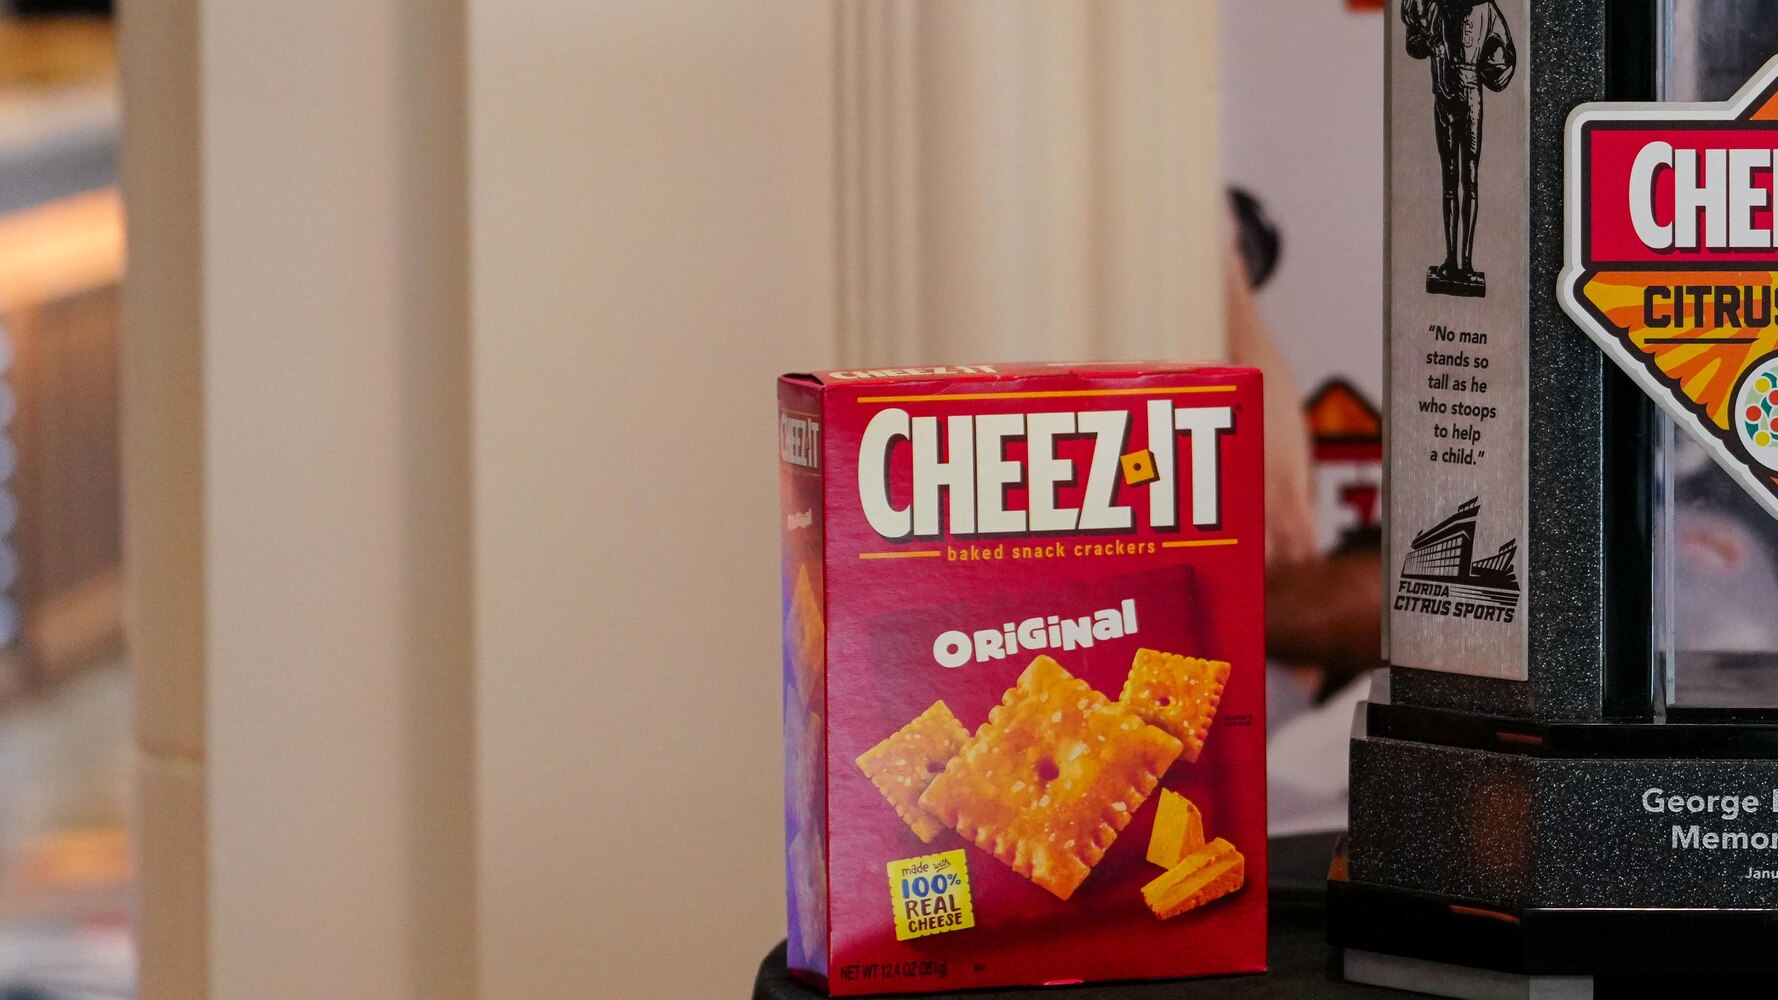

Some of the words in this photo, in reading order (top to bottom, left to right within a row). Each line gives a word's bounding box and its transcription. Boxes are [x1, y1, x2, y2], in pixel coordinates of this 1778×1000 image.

[1459, 331, 1487, 344] man
[1426, 351, 1470, 368] stands
[1473, 357, 1489, 369] so
[1428, 374, 1448, 390] tall
[1452, 379, 1467, 391] as
[1471, 376, 1487, 393] he
[1418, 397, 1447, 414] who
[1451, 401, 1496, 421] stoops
[1434, 424, 1448, 438] to
[1452, 423, 1481, 445] help
[1430, 450, 1437, 461] a
[947, 543, 1003, 561] baked
[1012, 541, 1066, 560] snack
[1074, 539, 1157, 557] crackers
[1399, 580, 1450, 598] FLORIDA
[1393, 596, 1452, 616] CITRUS
[1452, 602, 1515, 623] SPORTS
[1641, 788, 1759, 820] George
[902, 861, 929, 877] made
[932, 858, 951, 873] with
[902, 873, 962, 899] 100%
[905, 894, 961, 919] REAL
[908, 912, 962, 933] CHEESE
[840, 965, 860, 980] NET
[862, 963, 879, 979] WT
[902, 962, 917, 977] OZ
